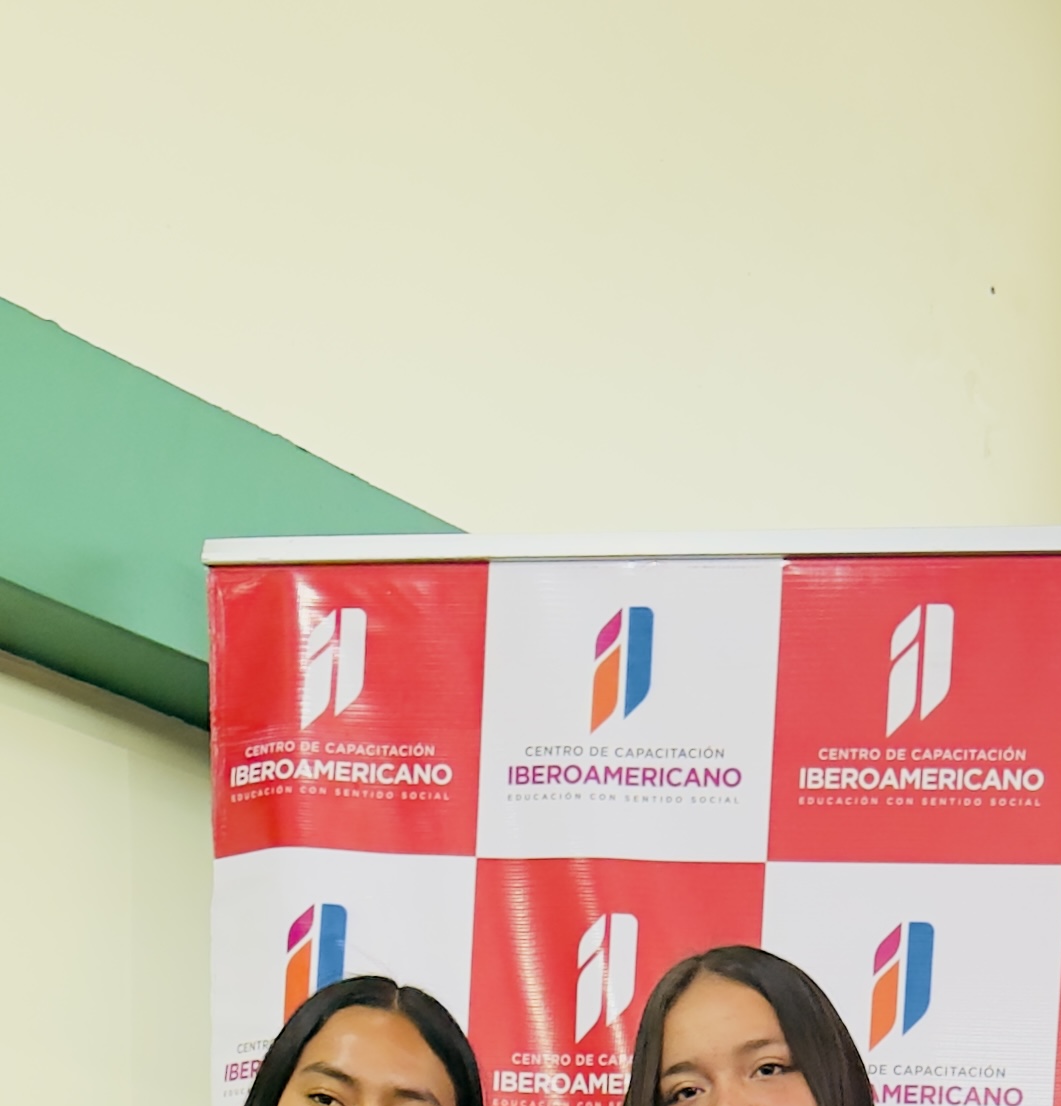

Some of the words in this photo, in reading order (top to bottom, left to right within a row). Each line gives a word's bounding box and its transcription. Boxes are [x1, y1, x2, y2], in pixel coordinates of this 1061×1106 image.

[245, 740, 295, 758] CENTRO
[301, 742, 320, 752] DE
[325, 742, 435, 756] CAPACITACIÓN
[525, 746, 583, 757] CENTRO
[590, 746, 608, 757] DE
[615, 746, 725, 759] CAPACITACIÓN
[818, 748, 881, 760] CENTRO
[886, 748, 906, 760] DE
[911, 746, 1026, 761] CAPACITACIÓN
[230, 758, 453, 788] IBEROAMERICANO
[508, 764, 742, 788] IBEROAMERICANO
[799, 767, 1044, 791] IBEROAMERICANO
[230, 785, 292, 802] EDUCACIÓN
[300, 786, 326, 794] CON
[335, 788, 393, 799] SENTIDO
[401, 792, 450, 800] SOCIAL
[507, 792, 582, 801] EDUCACIÓN
[590, 793, 616, 801] CON
[624, 794, 683, 804] SENTIDO
[691, 796, 740, 804] SOCIAL
[798, 796, 878, 806] EDUCACIÓN
[886, 797, 913, 806] CON
[921, 797, 982, 806] SENTIDO
[990, 798, 1040, 806] SOCIAL
[512, 1053, 572, 1066] CENTRO
[575, 1054, 594, 1066] DE
[868, 1064, 887, 1075] DE
[894, 1065, 1006, 1078] CAPACITACIÓN
